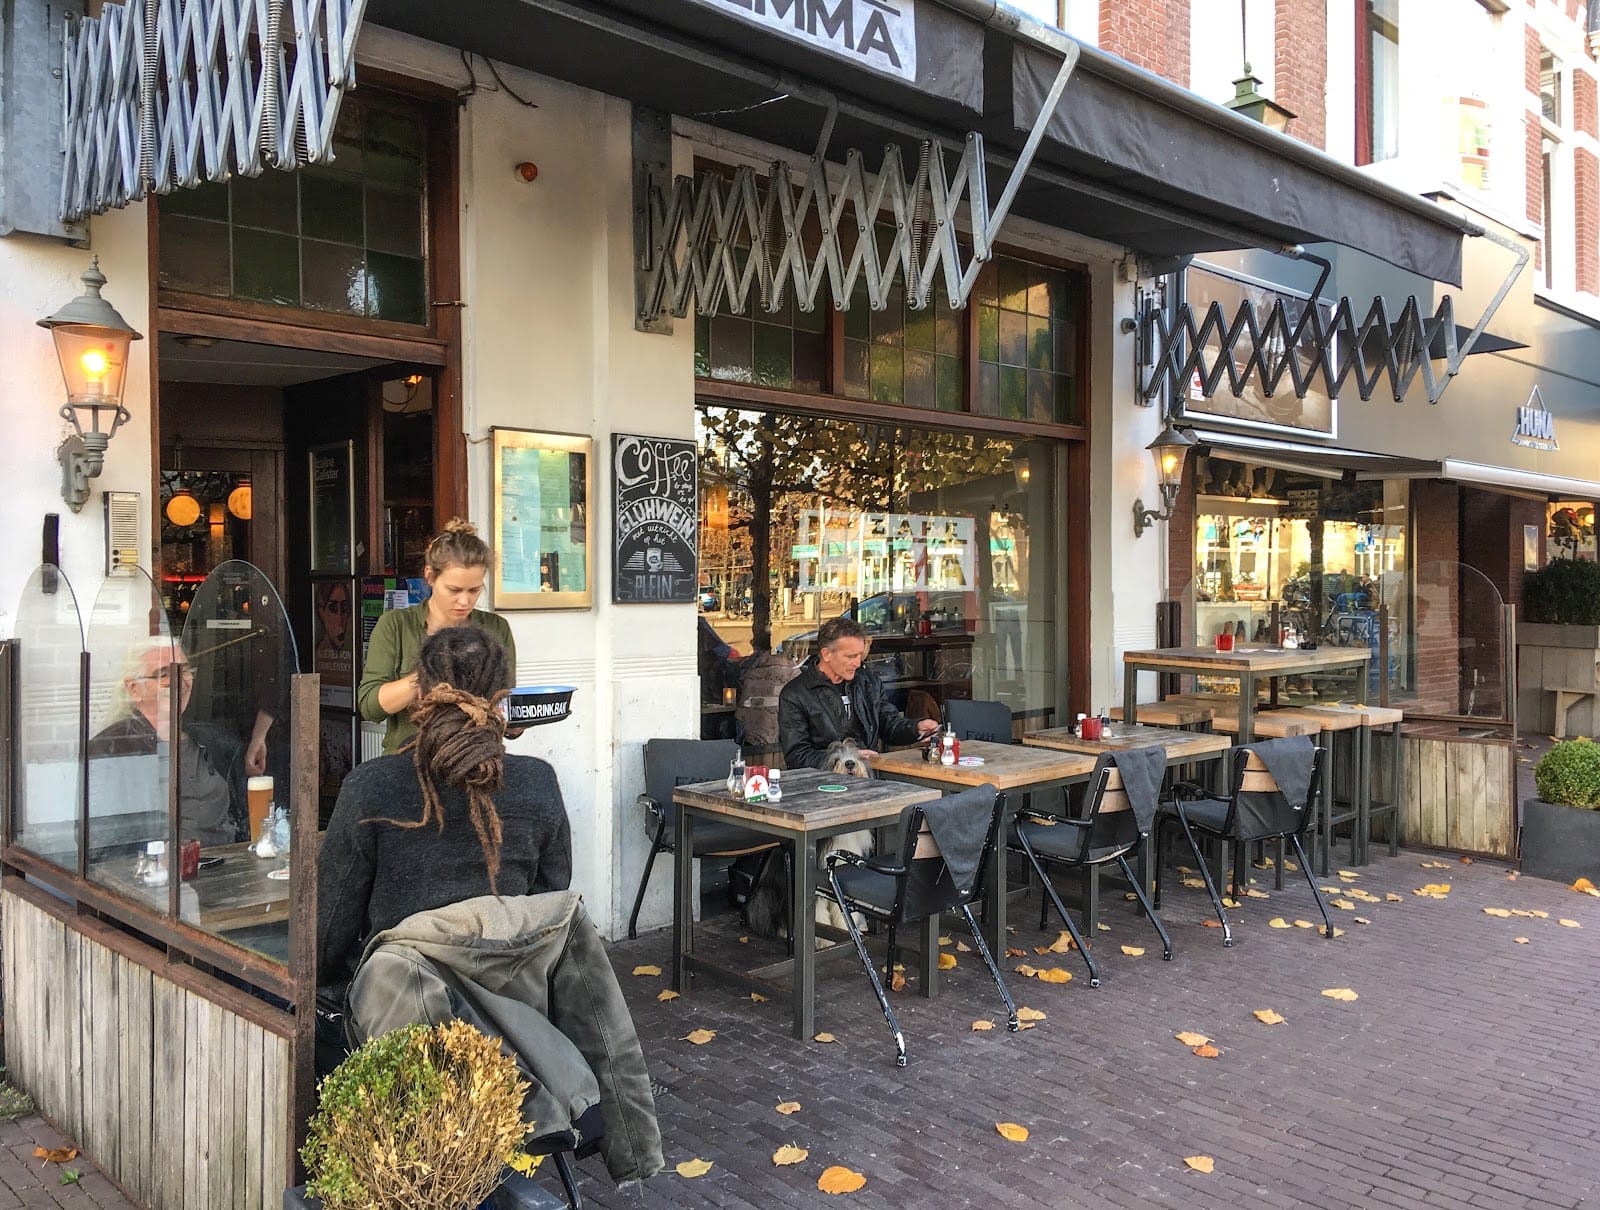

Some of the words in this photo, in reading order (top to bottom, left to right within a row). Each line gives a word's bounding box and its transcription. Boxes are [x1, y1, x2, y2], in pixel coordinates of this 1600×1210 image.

[726, 0, 902, 69] MMA
[615, 438, 695, 498] Coffee
[619, 499, 695, 540] GLÜHWEIN
[635, 574, 673, 599] PLEIN
